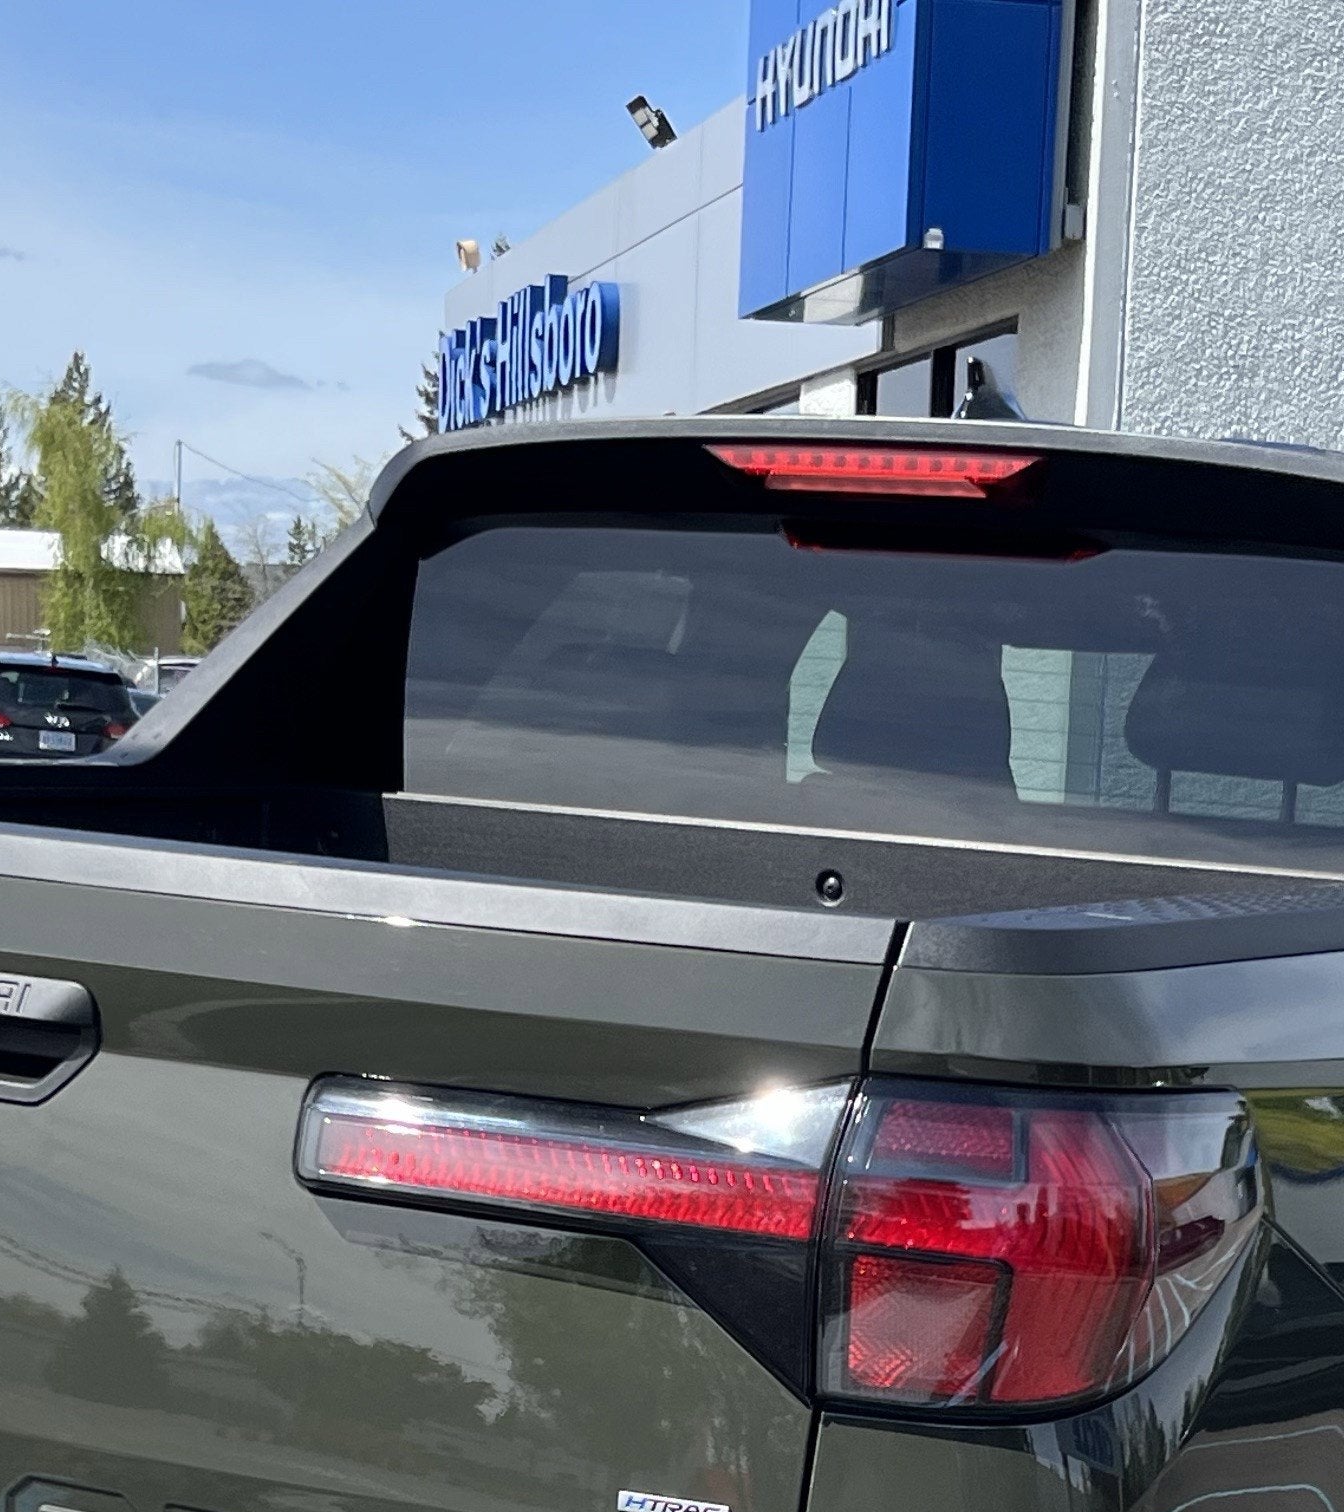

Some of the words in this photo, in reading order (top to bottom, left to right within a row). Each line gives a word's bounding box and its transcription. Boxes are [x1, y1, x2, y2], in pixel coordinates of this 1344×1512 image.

[756, 0, 894, 133] HYUNDAI
[438, 316, 498, 434] Dick's
[496, 274, 616, 411] Hillsboro
